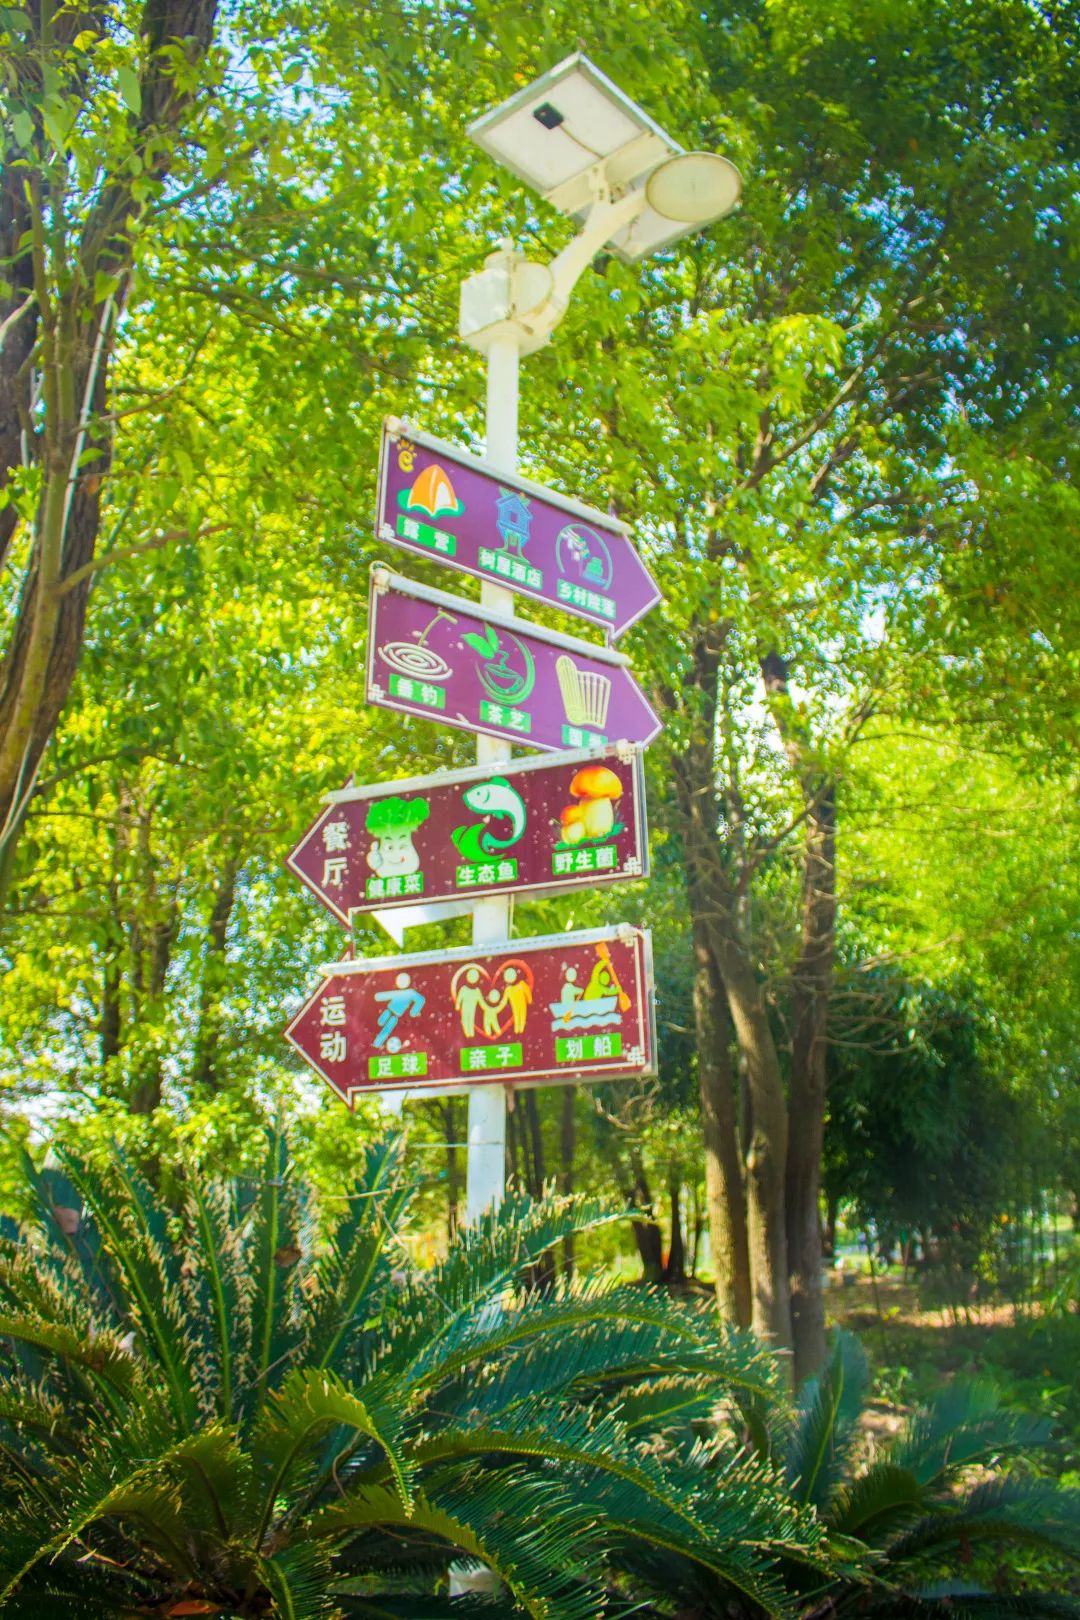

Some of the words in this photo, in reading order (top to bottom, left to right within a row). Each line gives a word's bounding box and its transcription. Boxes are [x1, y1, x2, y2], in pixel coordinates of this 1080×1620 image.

[488, 703, 526, 731] 茶艺
[321, 821, 350, 888] 餐厅
[554, 846, 614, 873] 野生菌
[458, 861, 515, 885] 生态鱼
[320, 995, 347, 1063] 运动
[468, 1045, 513, 1069] 亲子
[565, 1036, 613, 1059] 划船
[377, 1054, 421, 1077] 足球
